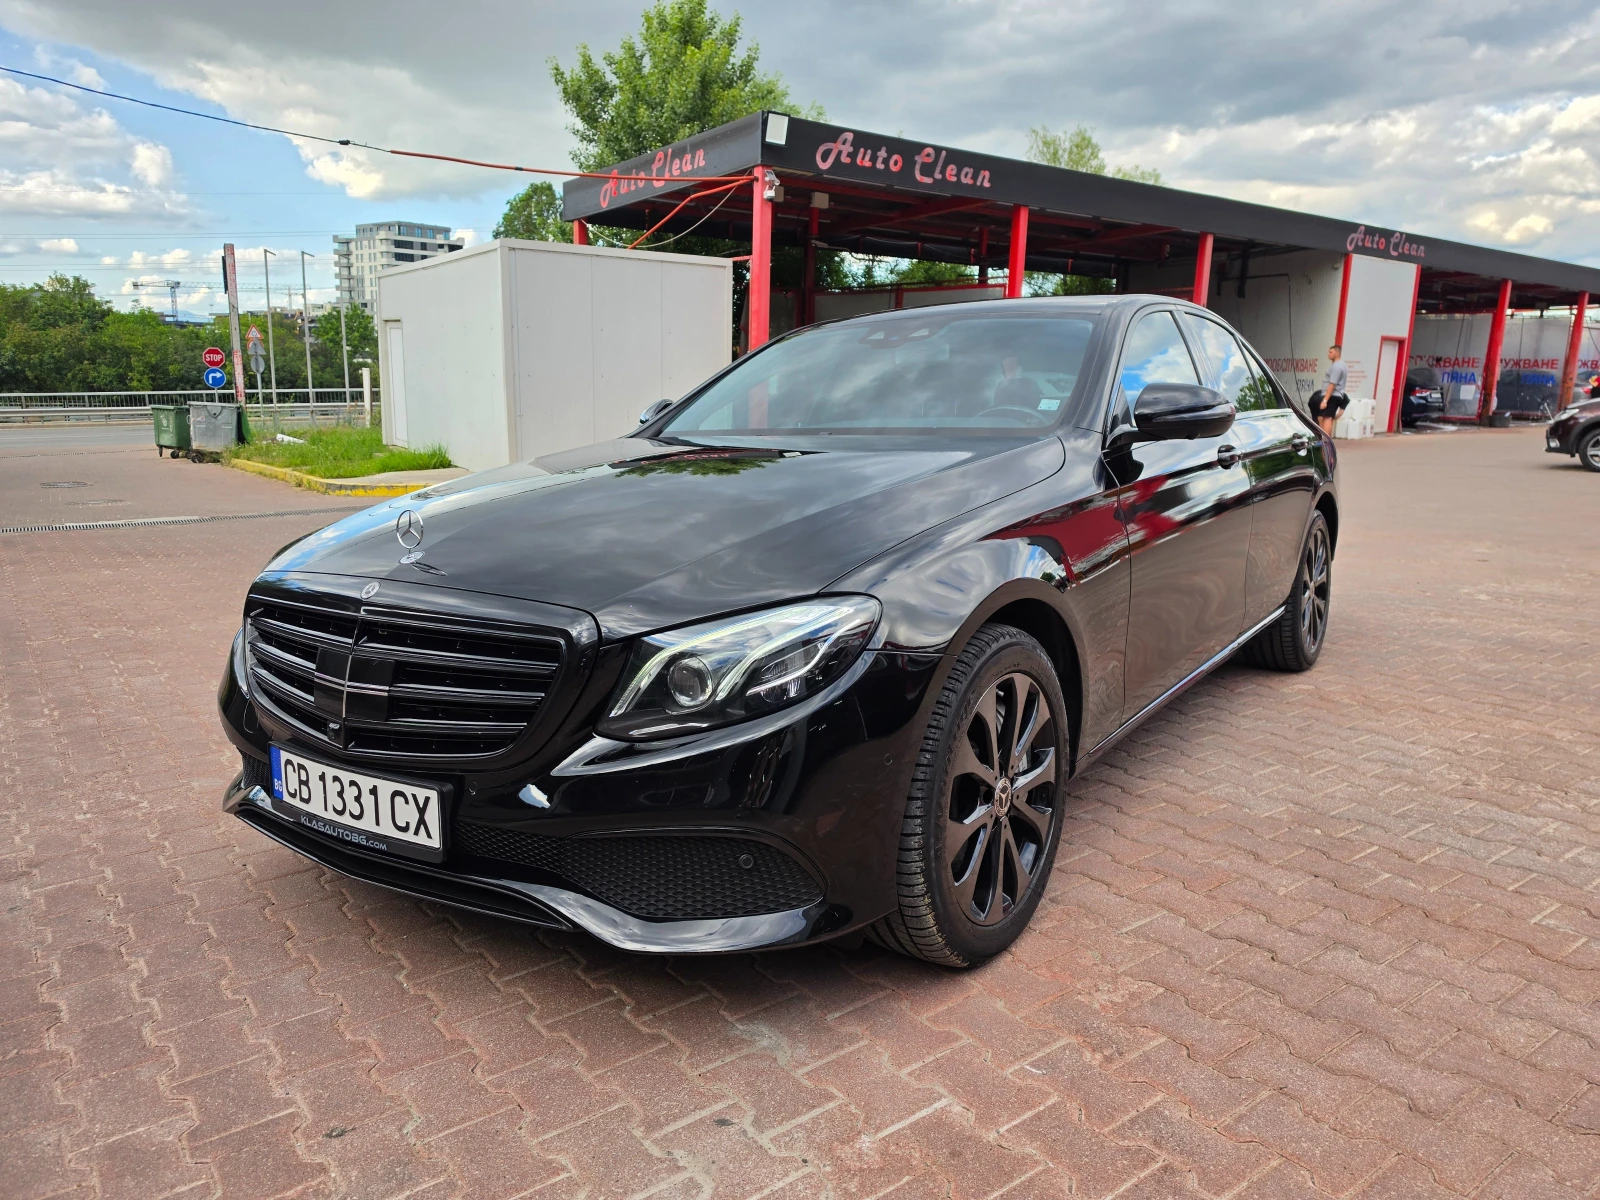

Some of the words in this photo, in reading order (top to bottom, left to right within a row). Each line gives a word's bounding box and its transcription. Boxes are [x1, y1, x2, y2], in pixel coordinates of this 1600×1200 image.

[815, 132, 903, 172] Auto
[914, 147, 991, 188] Clean
[600, 169, 646, 208] Auto
[651, 148, 706, 188] Clean
[1346, 225, 1386, 251] Auto
[1389, 232, 1425, 258] Clean
[205, 353, 223, 362] STOP
[274, 778, 283, 792] BG
